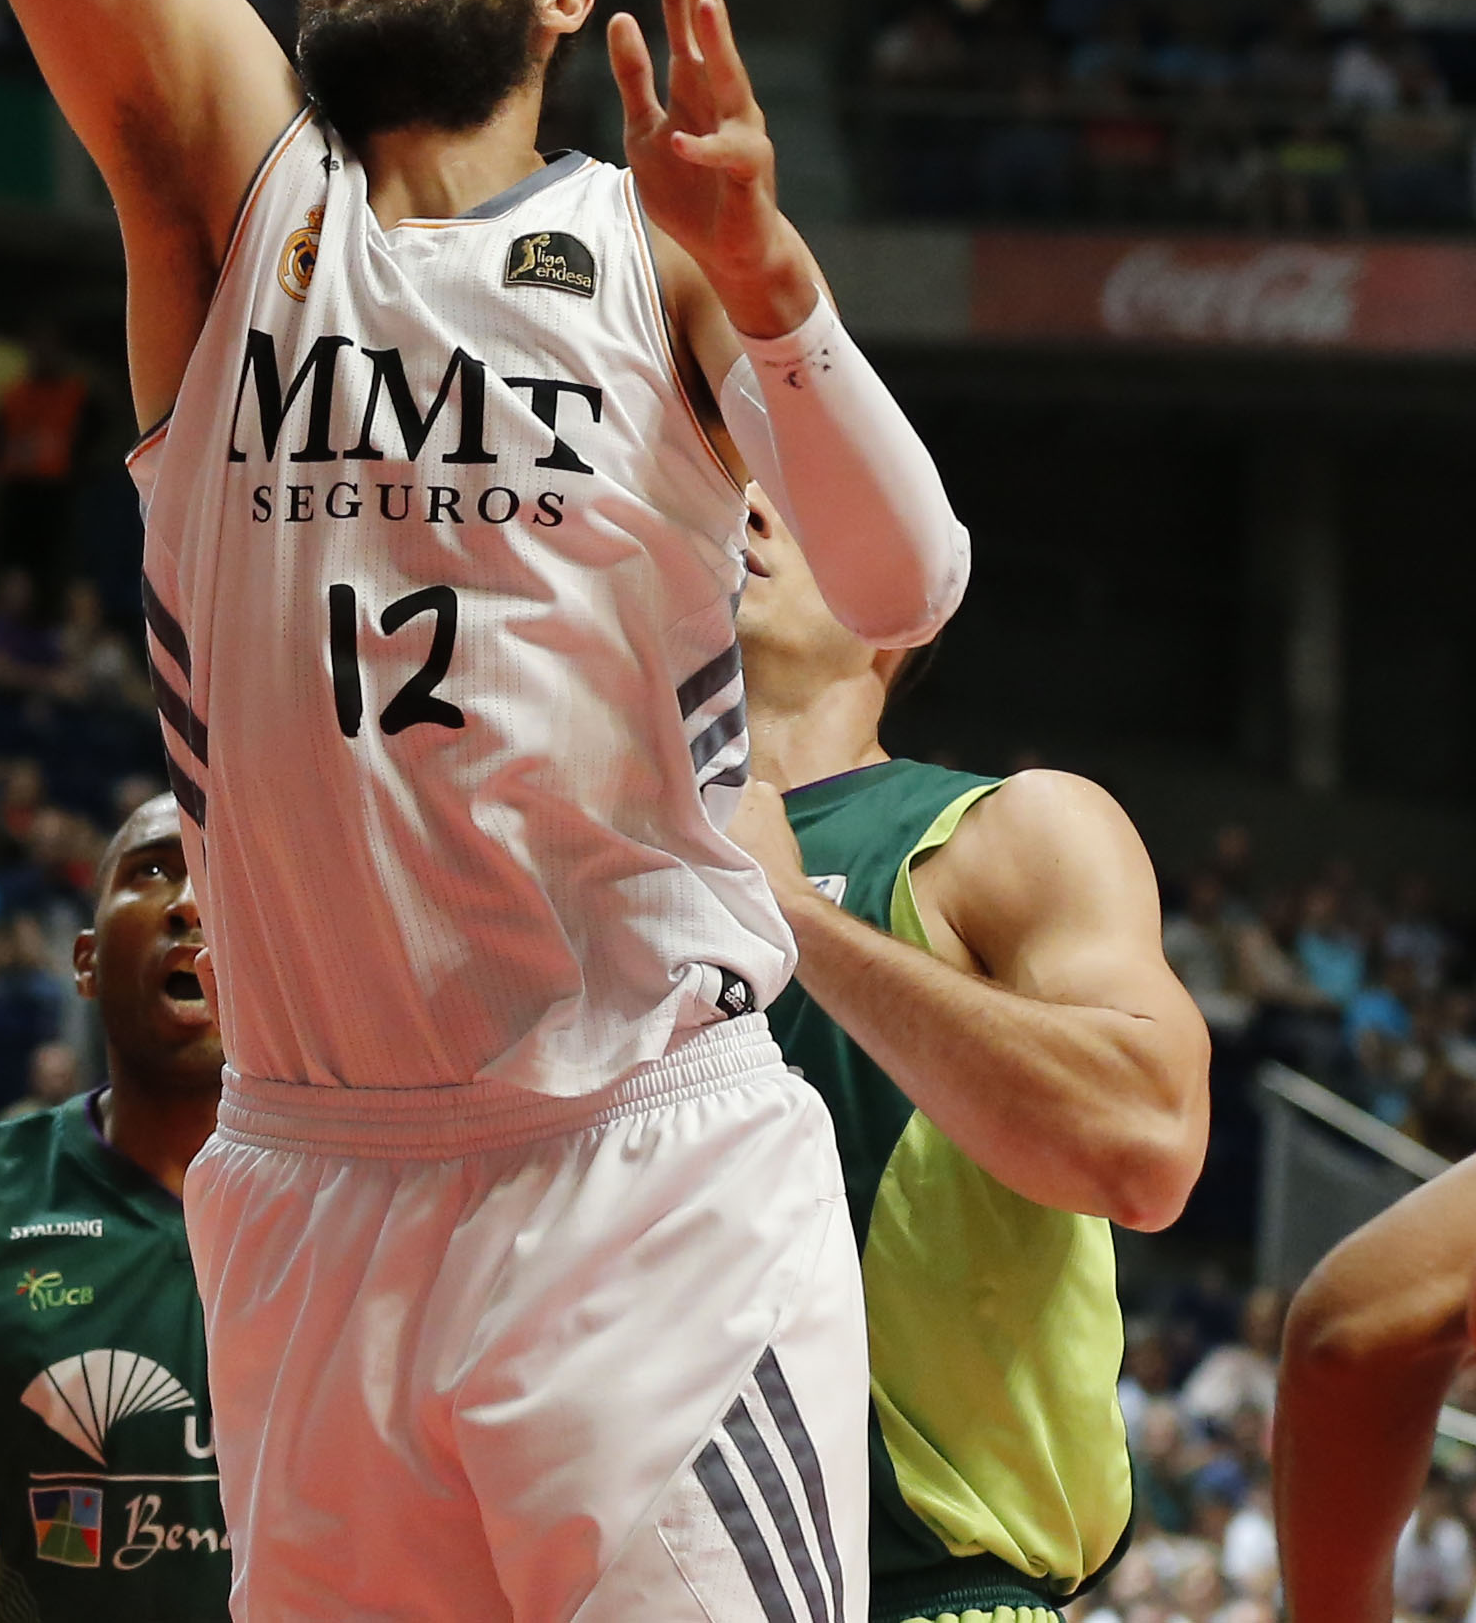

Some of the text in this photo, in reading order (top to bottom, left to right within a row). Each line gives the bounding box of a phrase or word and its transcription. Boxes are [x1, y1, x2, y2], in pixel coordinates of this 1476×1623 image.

[537, 246, 567, 267] liga
[535, 266, 592, 289] endesa
[229, 329, 603, 475] MMT
[251, 482, 566, 527] SEGUROS
[328, 583, 466, 739] 12
[9, 1219, 103, 1241] SPALDING
